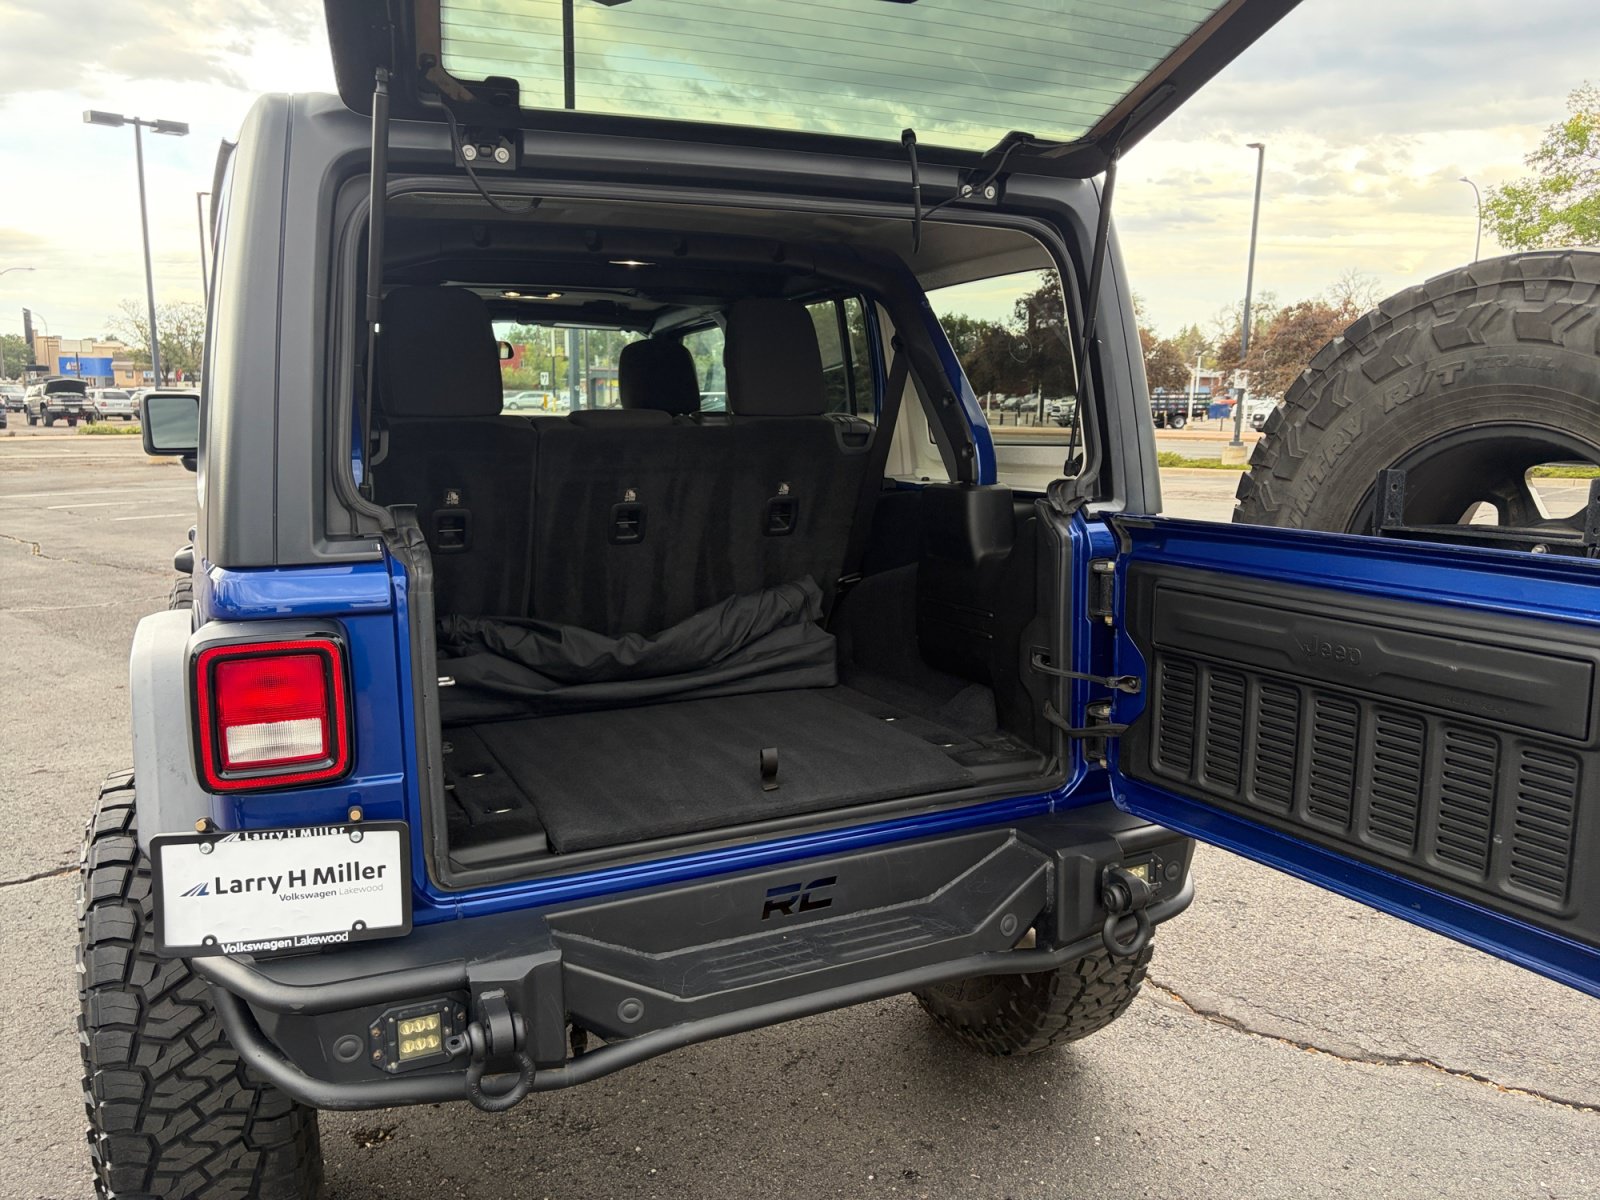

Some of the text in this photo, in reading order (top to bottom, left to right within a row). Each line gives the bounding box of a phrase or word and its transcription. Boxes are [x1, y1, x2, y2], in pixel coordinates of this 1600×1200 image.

[1303, 636, 1362, 664] Jeep
[245, 826, 345, 842] Larry H Miller
[215, 861, 386, 896] Larry H Miller
[279, 883, 384, 902] Volkswagen Lakewood
[761, 876, 838, 920] RC
[221, 931, 349, 954] Volkswagen Lakewood
